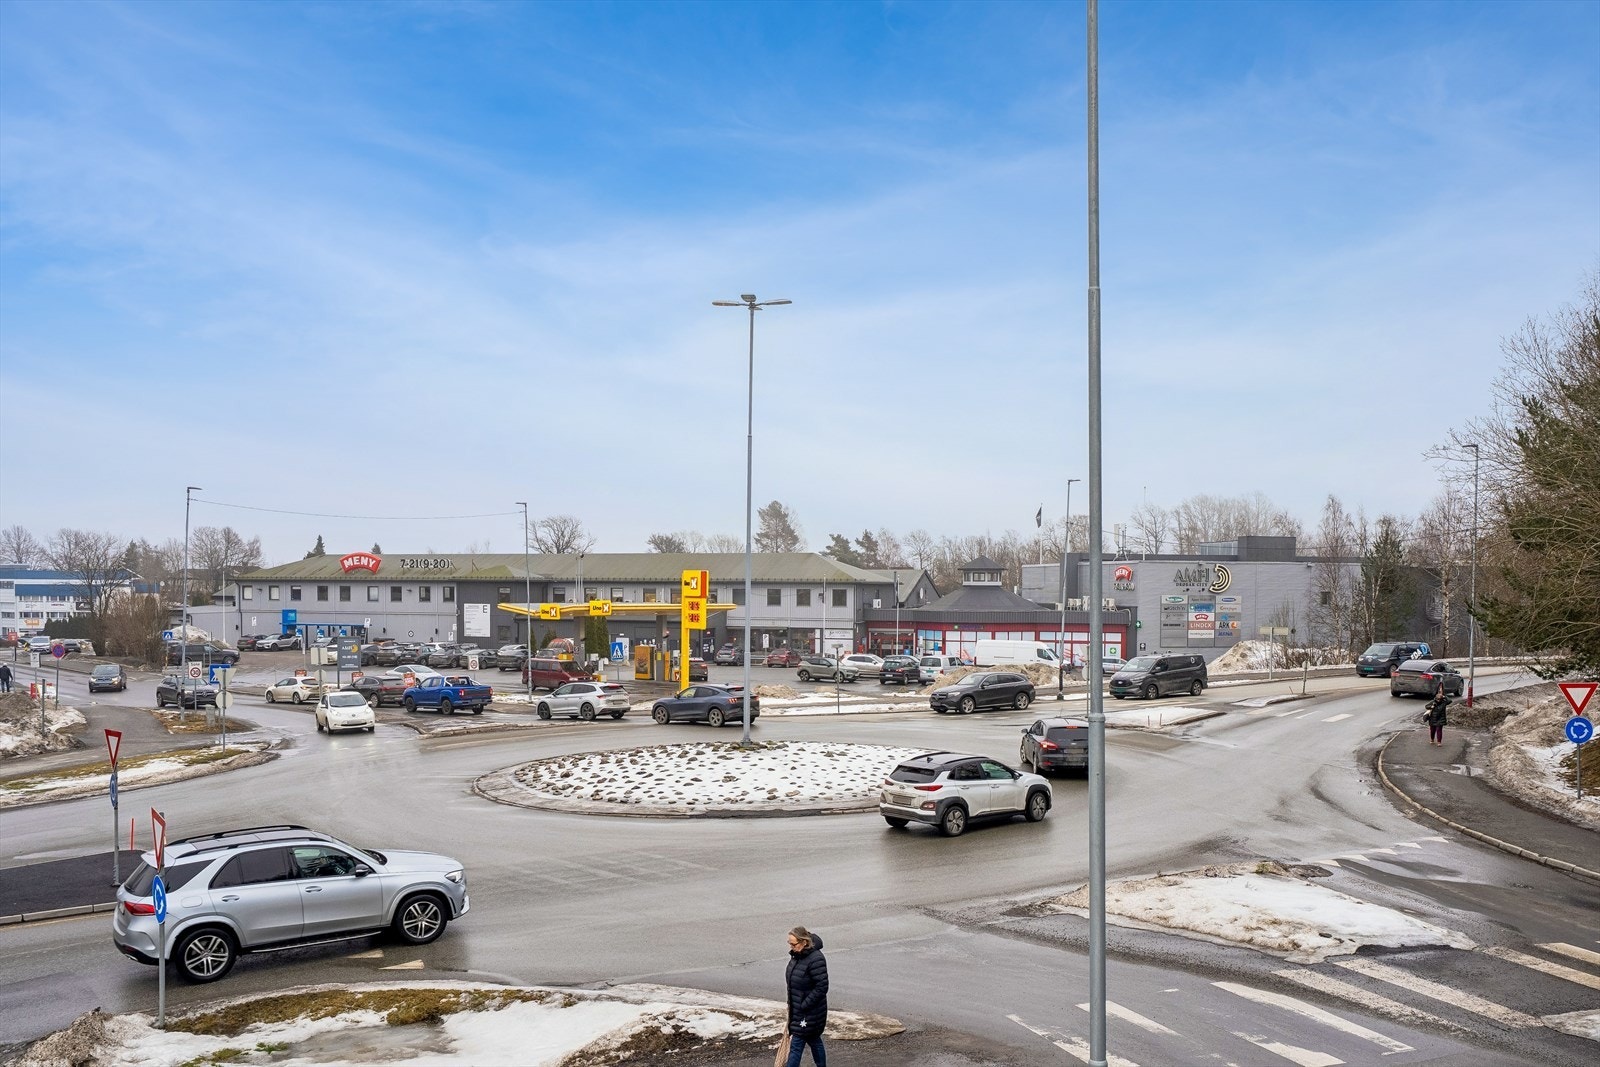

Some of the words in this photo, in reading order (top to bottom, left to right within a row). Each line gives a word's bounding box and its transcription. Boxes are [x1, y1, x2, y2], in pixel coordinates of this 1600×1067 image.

[343, 555, 376, 568] MENY
[400, 558, 450, 569] 7-21(9-20)
[482, 604, 488, 613] E
